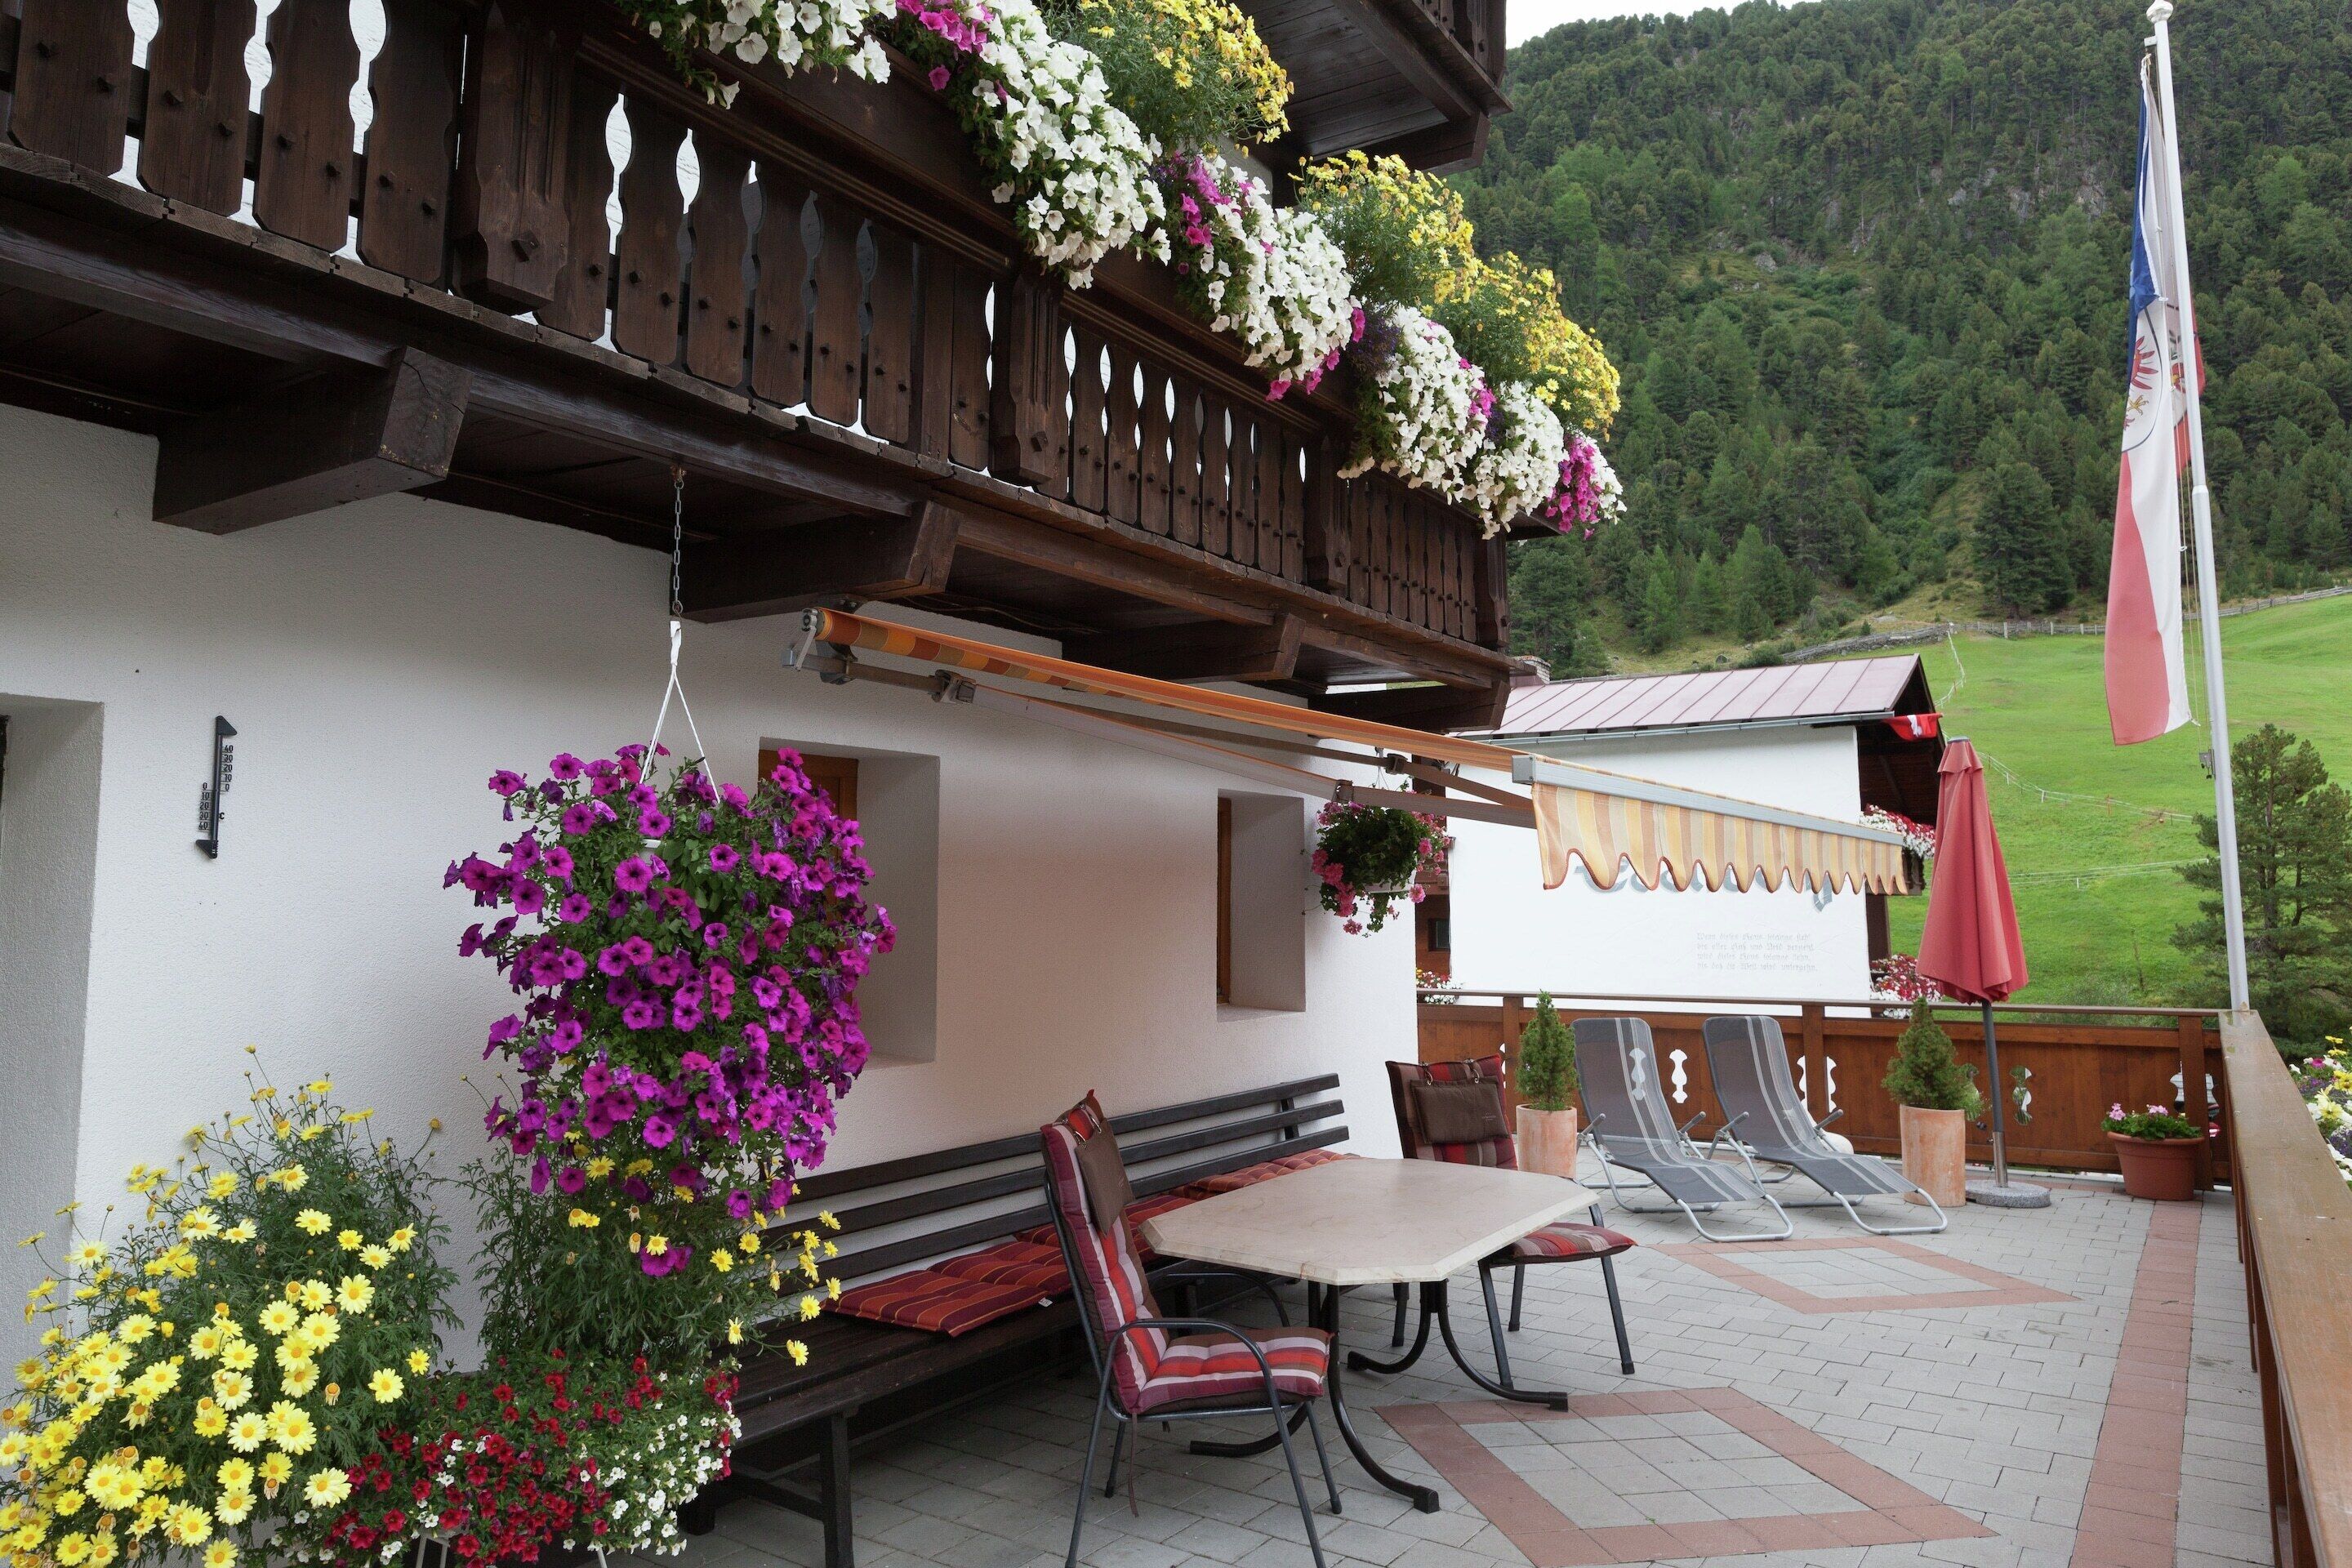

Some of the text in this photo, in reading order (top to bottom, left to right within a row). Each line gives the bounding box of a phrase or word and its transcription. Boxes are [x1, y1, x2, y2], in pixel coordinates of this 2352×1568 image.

[199, 802, 209, 810] 20
[199, 812, 208, 820] 30
[198, 822, 208, 830] 40
